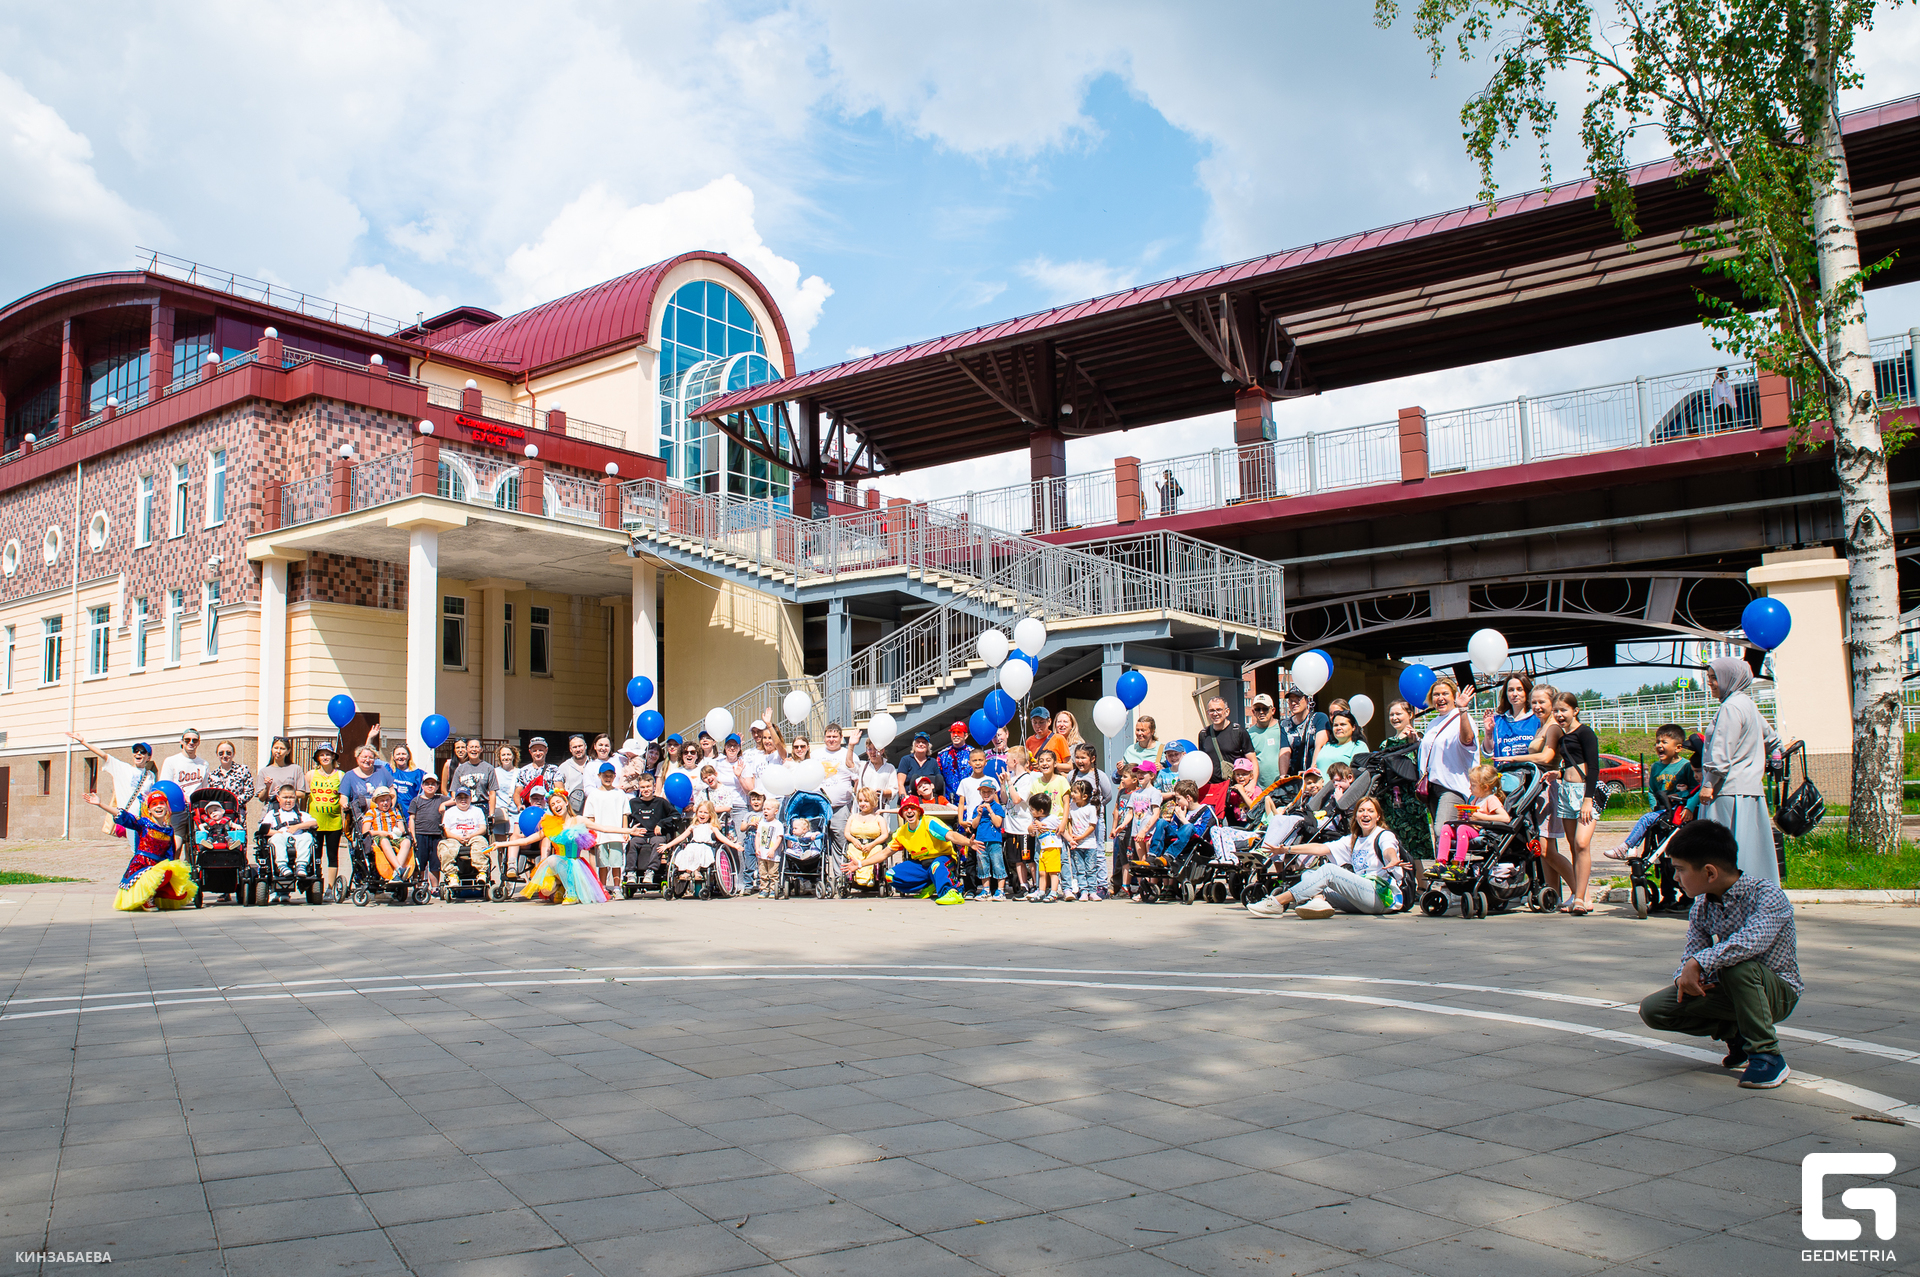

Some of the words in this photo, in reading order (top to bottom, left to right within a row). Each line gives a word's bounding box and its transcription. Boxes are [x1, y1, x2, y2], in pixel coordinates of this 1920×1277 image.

[455, 414, 525, 439] Станционный
[472, 430, 508, 447] БУФЕТ
[178, 768, 201, 783] Cool
